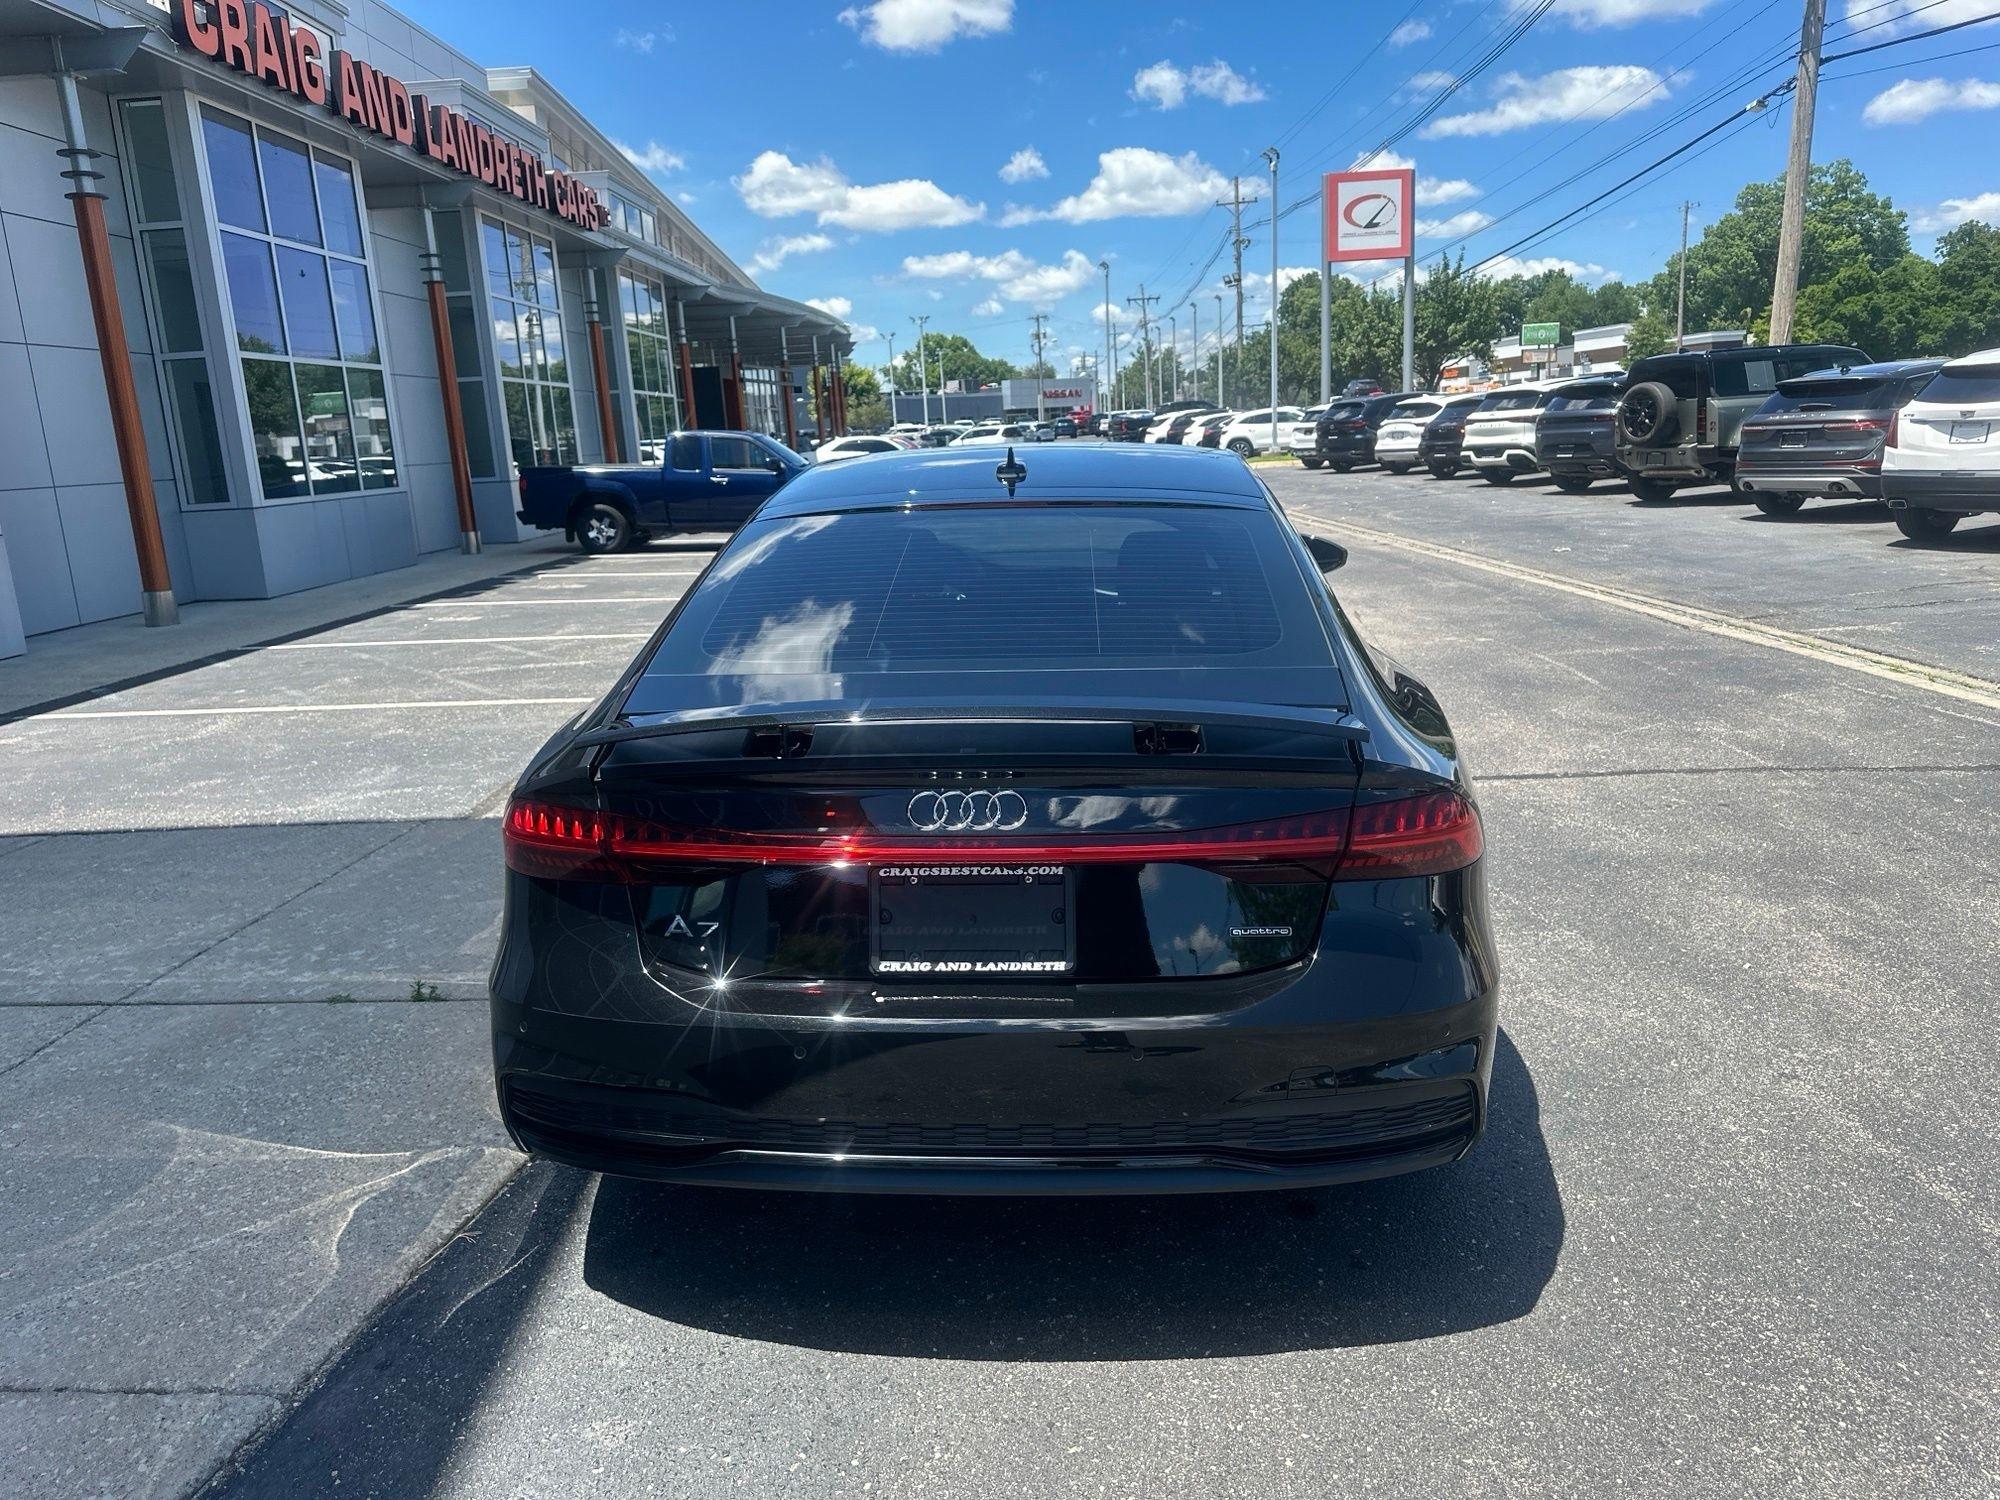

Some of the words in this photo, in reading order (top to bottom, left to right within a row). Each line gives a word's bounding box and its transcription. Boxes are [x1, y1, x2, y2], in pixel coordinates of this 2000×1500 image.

[180, 0, 326, 105] CRAIG
[335, 50, 413, 145] AND
[419, 94, 550, 209] LANDRETH
[551, 169, 599, 232] CARS
[1043, 389, 1082, 399] NISSAN
[664, 915, 719, 937] A7
[1232, 928, 1289, 936] quattro
[878, 961, 931, 972] CRAIG
[935, 961, 972, 972] AND
[975, 961, 1066, 972] LANDRETH
